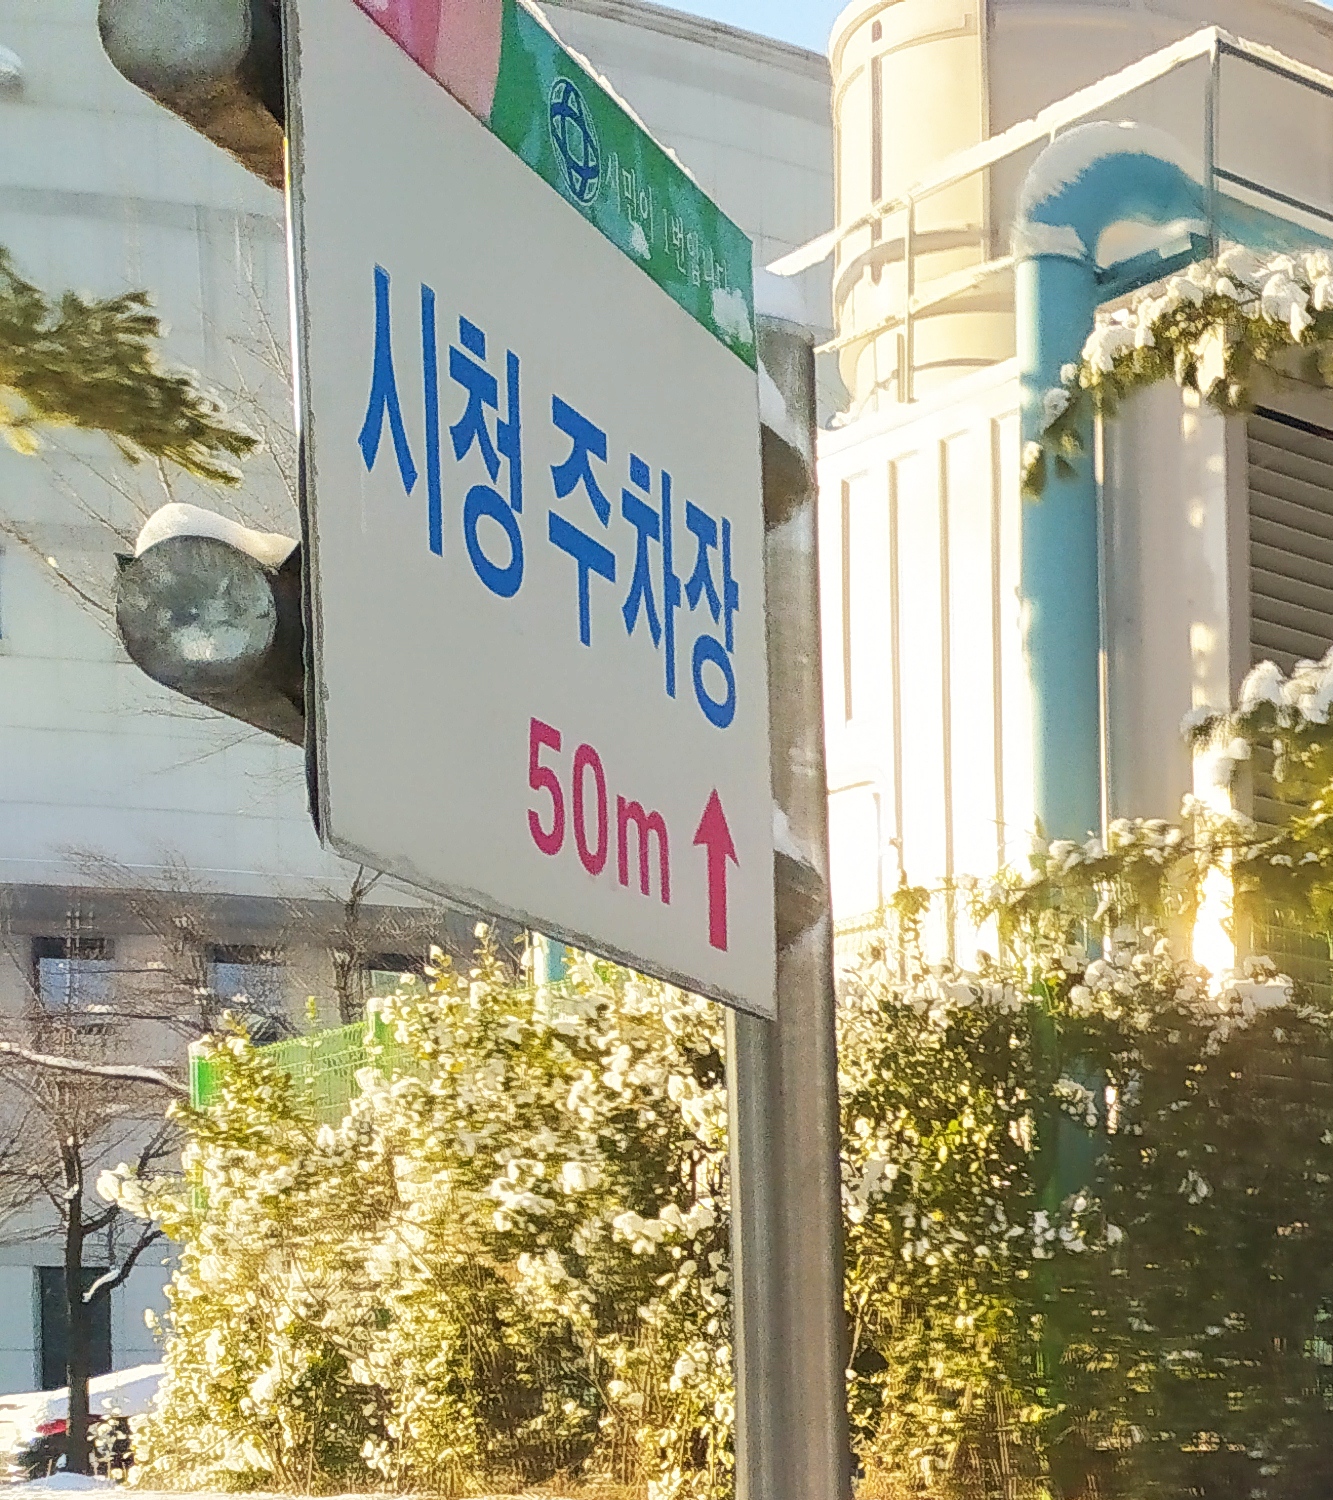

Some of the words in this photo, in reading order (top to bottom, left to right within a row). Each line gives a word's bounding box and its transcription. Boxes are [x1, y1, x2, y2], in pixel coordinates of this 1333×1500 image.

[357, 266, 525, 598] 시청
[548, 395, 740, 729] 주차장
[528, 717, 671, 904] 50m
